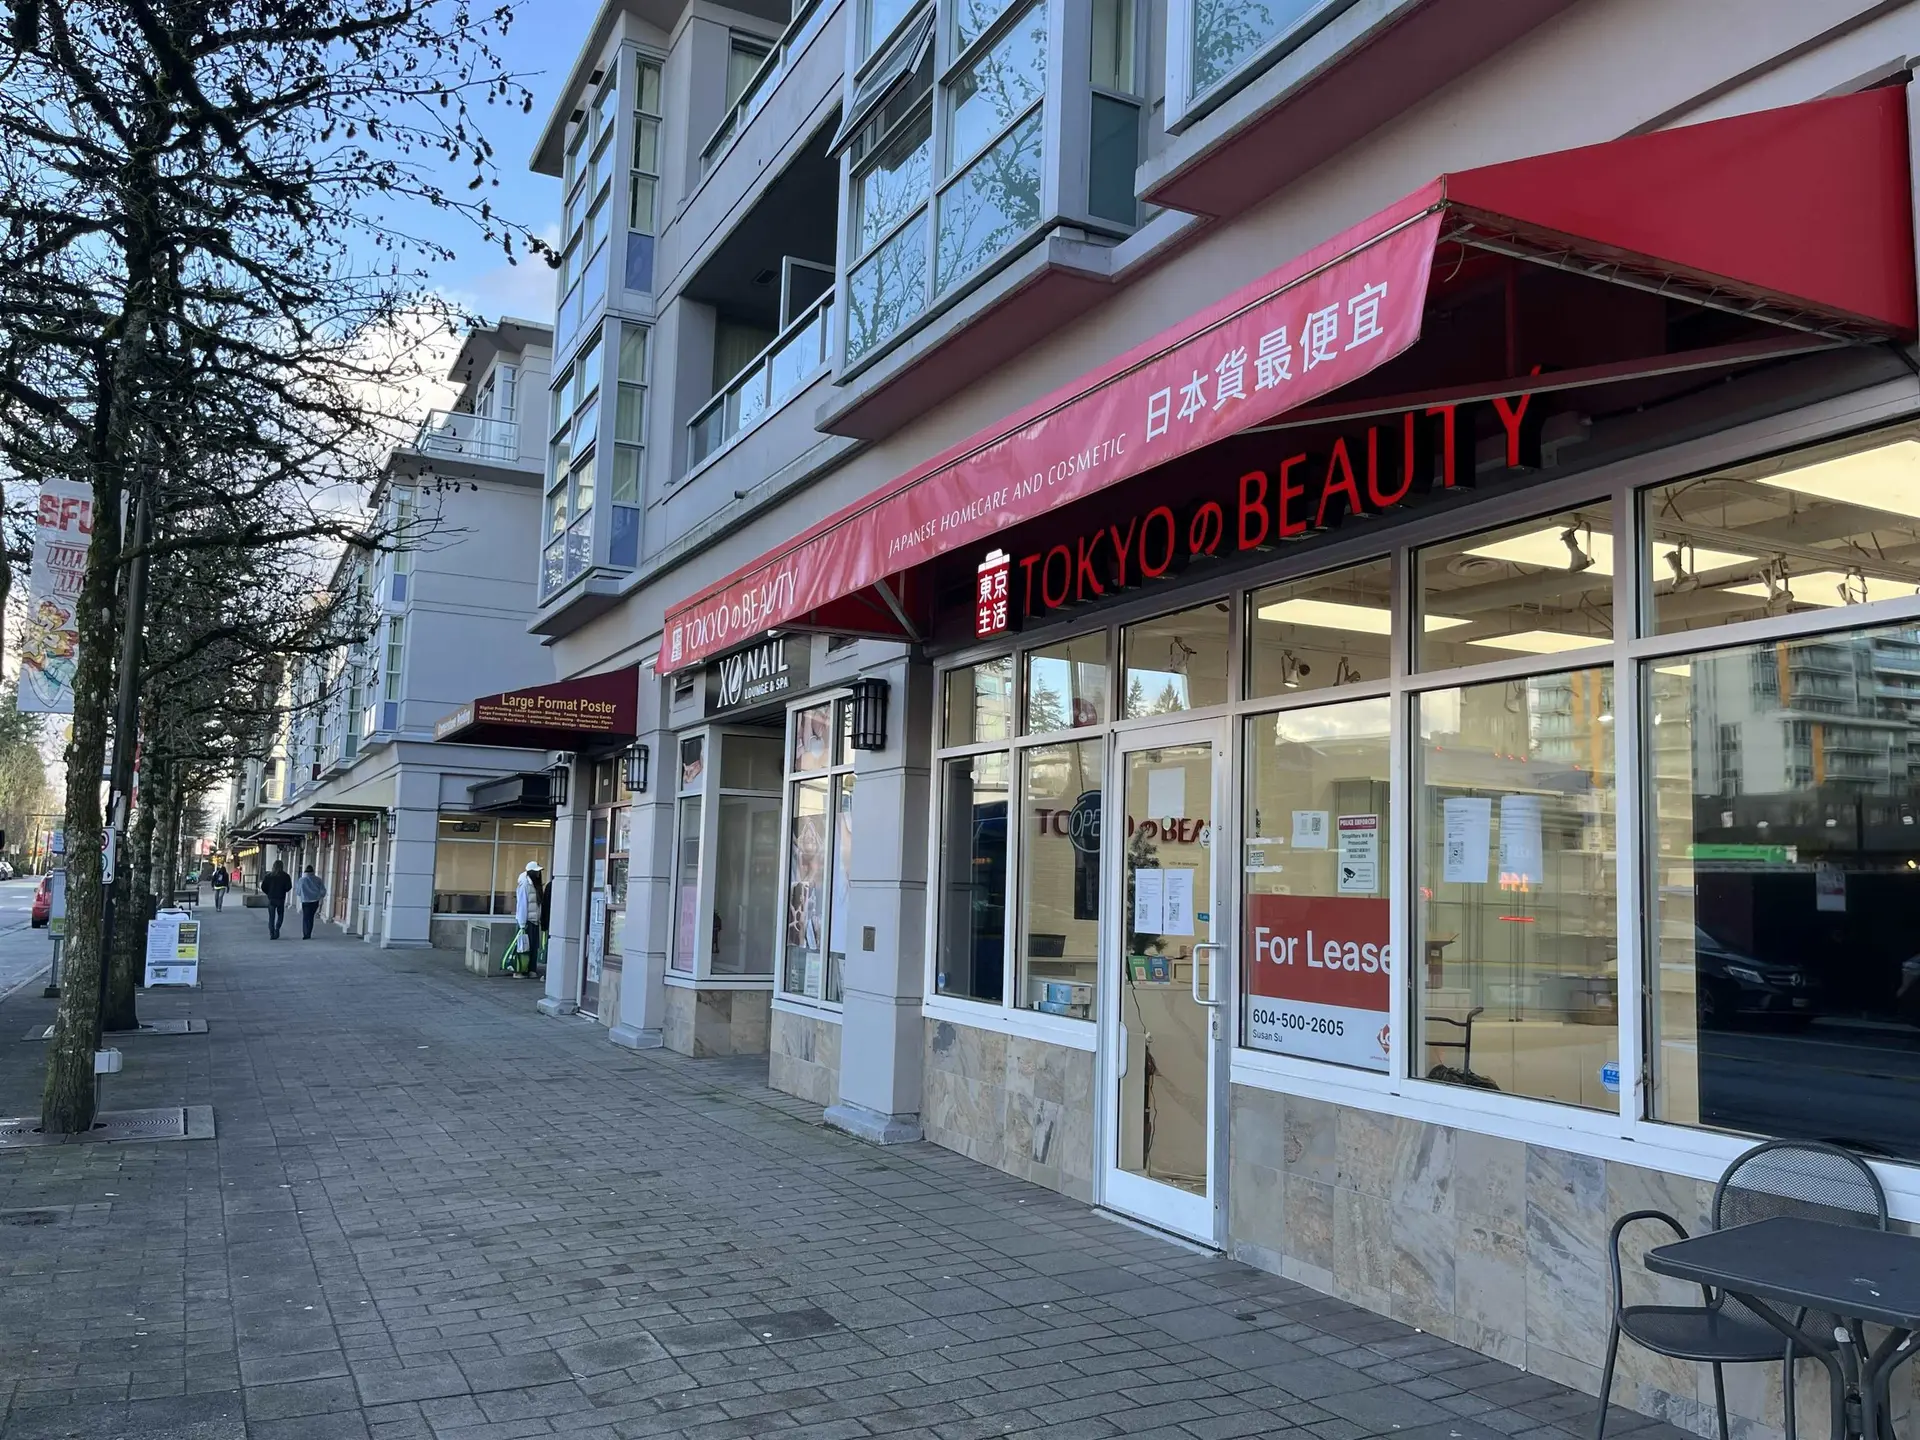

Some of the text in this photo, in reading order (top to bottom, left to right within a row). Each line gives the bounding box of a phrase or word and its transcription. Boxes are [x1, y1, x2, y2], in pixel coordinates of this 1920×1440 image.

[1146, 281, 1388, 443] 日本貨最便宜
[888, 432, 1127, 559] JAPANESE HOMECARE AND COSMETIC
[1019, 506, 1176, 618] TOKYO
[1238, 365, 1541, 551] BEAUTY
[979, 568, 1009, 604] 東京
[685, 605, 730, 653] TOKYO
[742, 567, 799, 629] BEAUTY
[978, 600, 1008, 634] 生活
[746, 639, 790, 683] NAIL
[501, 693, 617, 714] Large Format Poster
[744, 676, 790, 700] LOUNGE & SPA
[1071, 808, 1101, 837] OPE
[1254, 926, 1391, 976] For Lease
[1252, 1008, 1345, 1037] 604-500-2605
[1252, 1029, 1283, 1043] Susan Su
